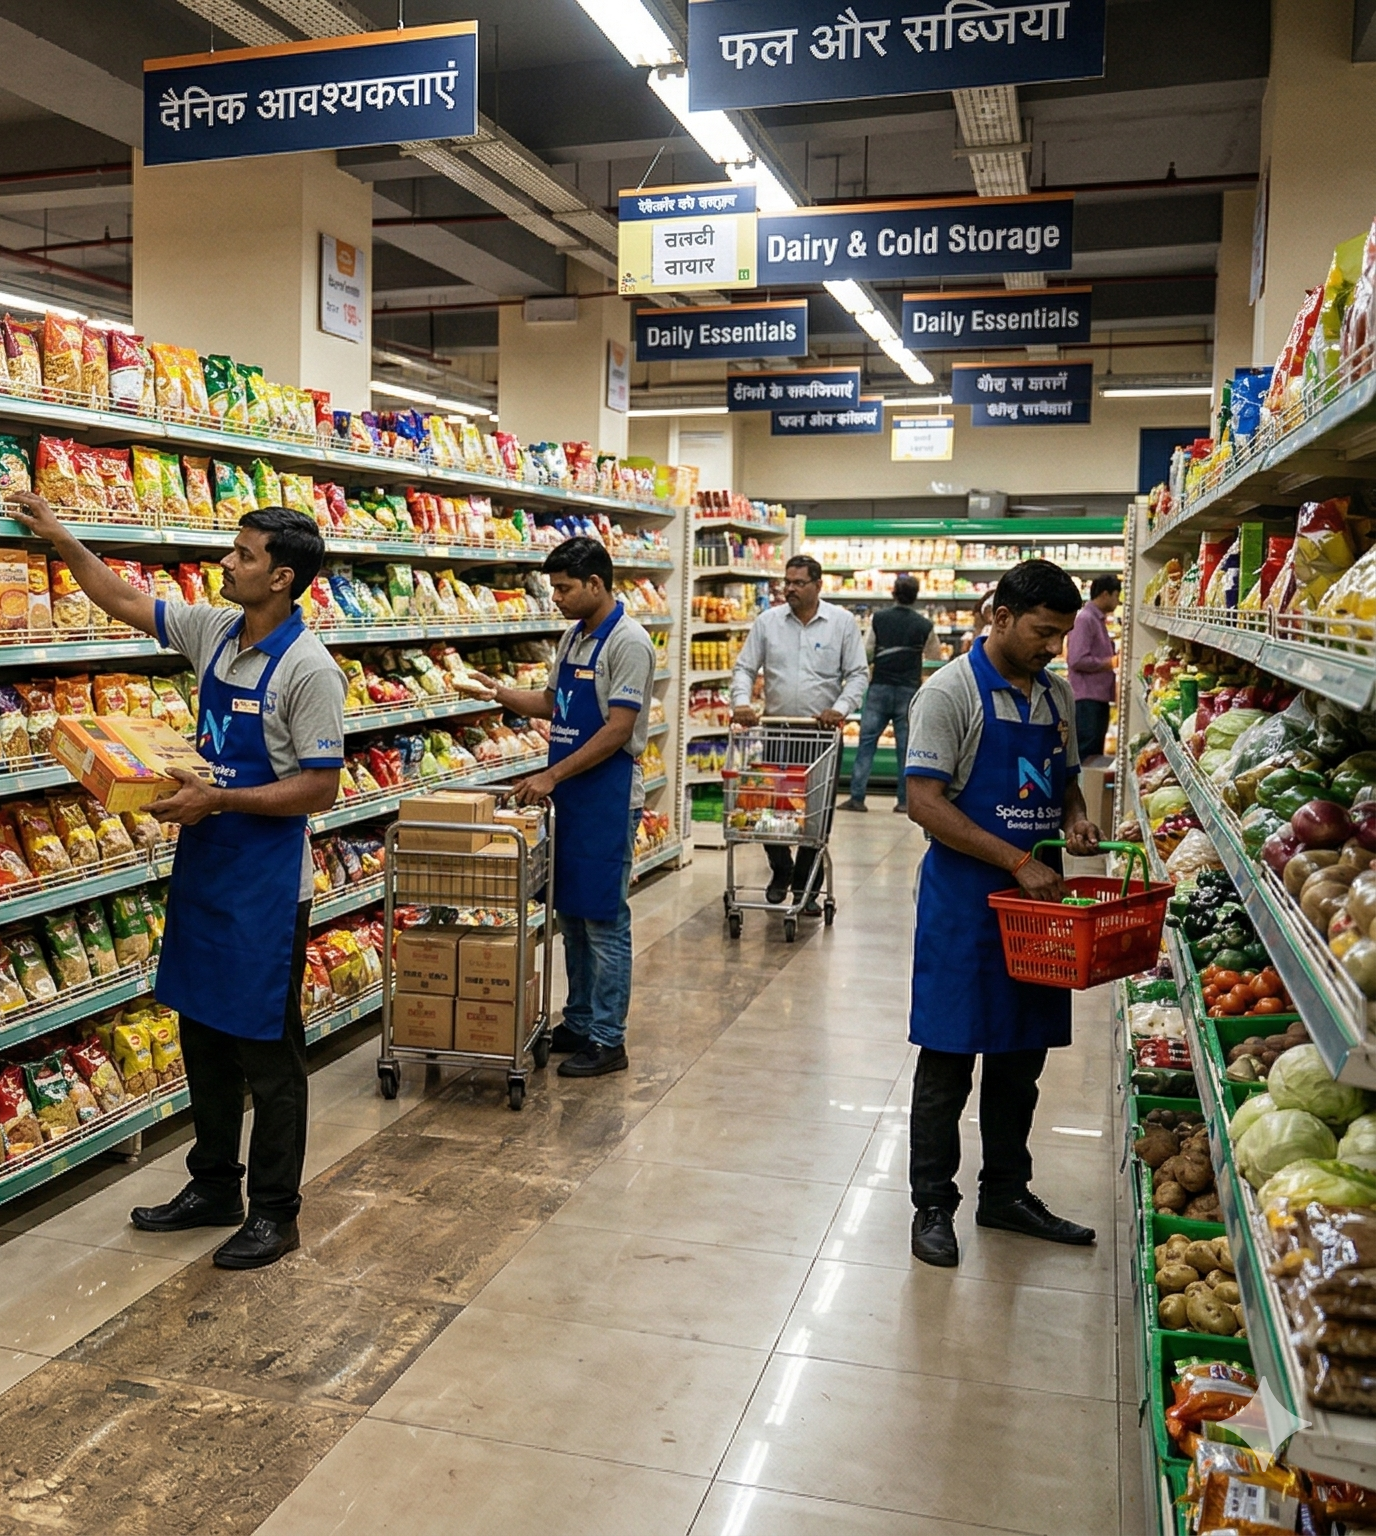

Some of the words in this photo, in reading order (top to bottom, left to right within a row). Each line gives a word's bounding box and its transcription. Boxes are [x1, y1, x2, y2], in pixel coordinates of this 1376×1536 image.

[719, 28, 798, 70] फल
[809, 7, 891, 60] और
[159, 86, 248, 131] दैनिक
[257, 60, 459, 118] आवश्यकताएं
[768, 229, 839, 266] Dairy
[847, 230, 868, 258] &
[877, 226, 939, 257] Cold
[948, 223, 1061, 257] Storage
[646, 324, 694, 350] Daily
[699, 319, 797, 345] Essentials
[912, 310, 965, 337] Daily
[971, 307, 1080, 333] Essentials
[996, 804, 1035, 820] Spices
